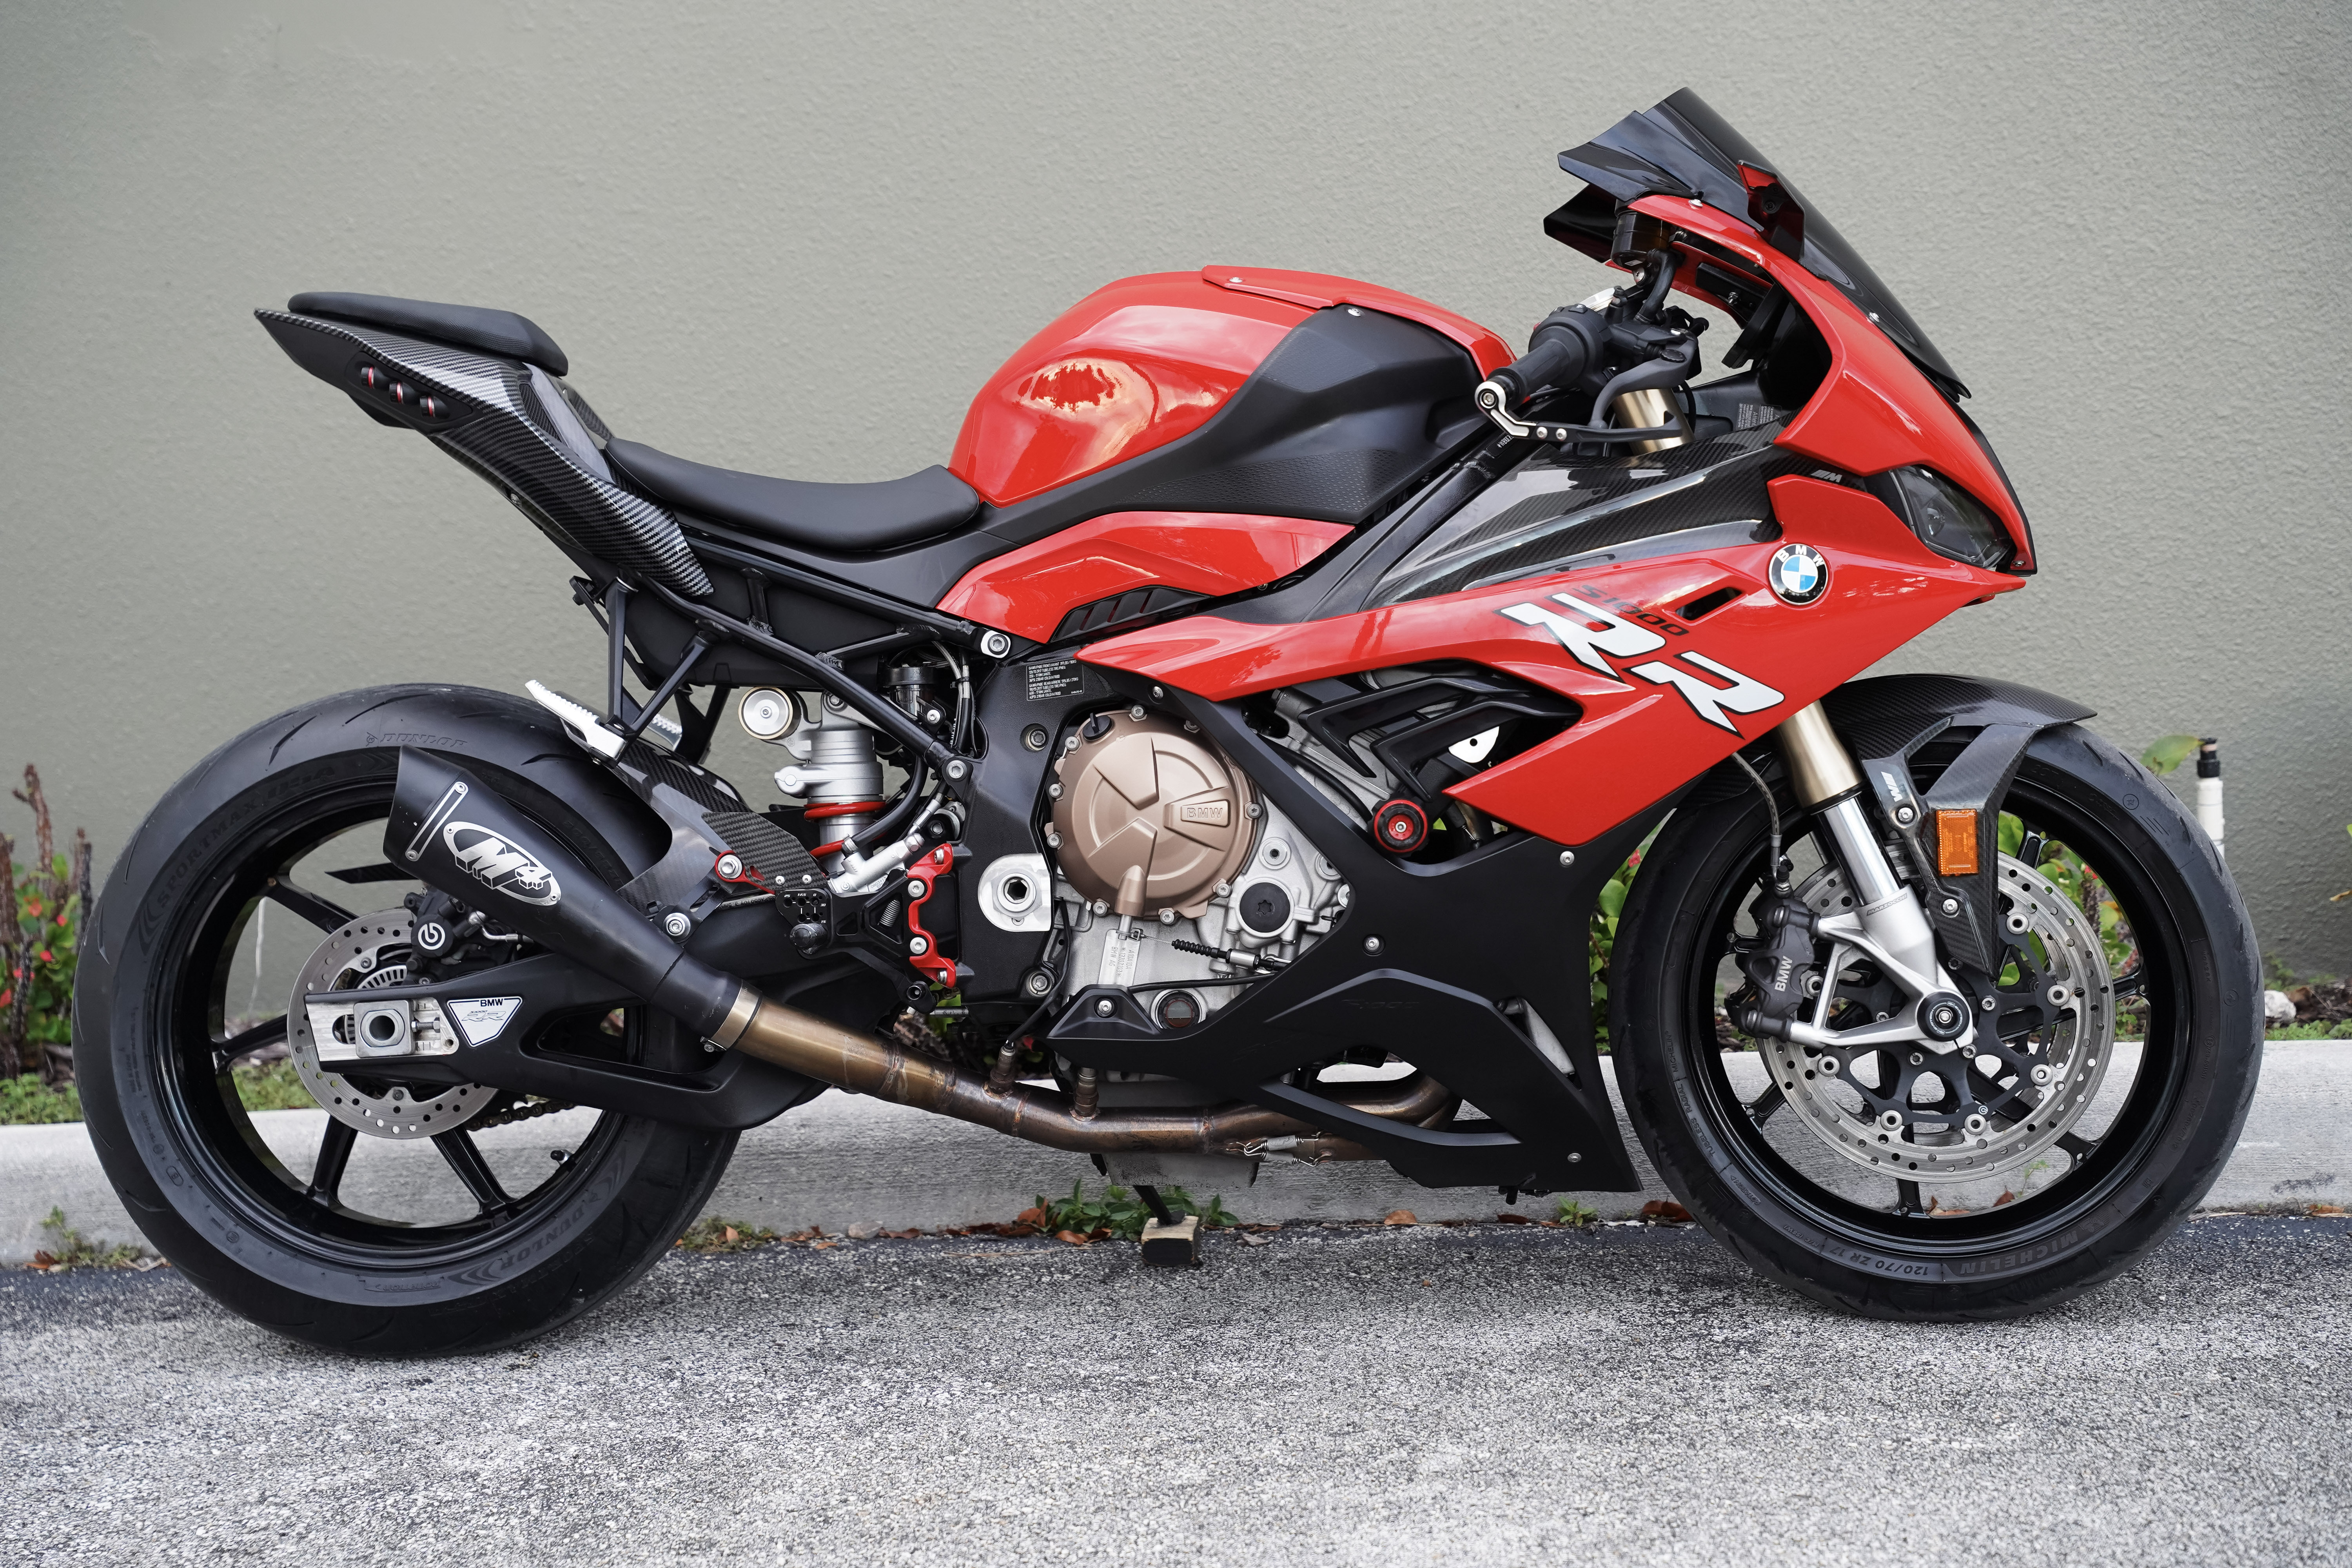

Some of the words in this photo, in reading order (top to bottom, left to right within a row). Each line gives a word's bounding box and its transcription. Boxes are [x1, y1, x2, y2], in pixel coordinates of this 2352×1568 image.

[1777, 545, 1825, 567] BMW
[1572, 585, 1689, 636] S1000
[1495, 592, 1785, 740] RR
[380, 733, 468, 748] DUNLOP
[1187, 808, 1223, 818] BMW
[455, 837, 552, 890] M4
[1866, 893, 1907, 916] MARZOCCHI
[1110, 946, 1118, 958] BMW
[1125, 949, 1135, 969] A10A10A
[1774, 955, 1793, 992] BMW
[461, 1011, 506, 1022] RR
[1676, 1083, 1693, 1113] RADIAL
[1689, 1116, 1717, 1157] TUBELESS
[1731, 1177, 1761, 1207] ROTATION
[500, 1205, 585, 1271] DUNLOP
[1802, 1235, 1819, 1249] M/C
[1828, 1243, 1846, 1258] 17
[1848, 1250, 1871, 1267] ZR
[1959, 1229, 2081, 1275] MICHELIN
[1874, 1258, 1929, 1276] 120/70
